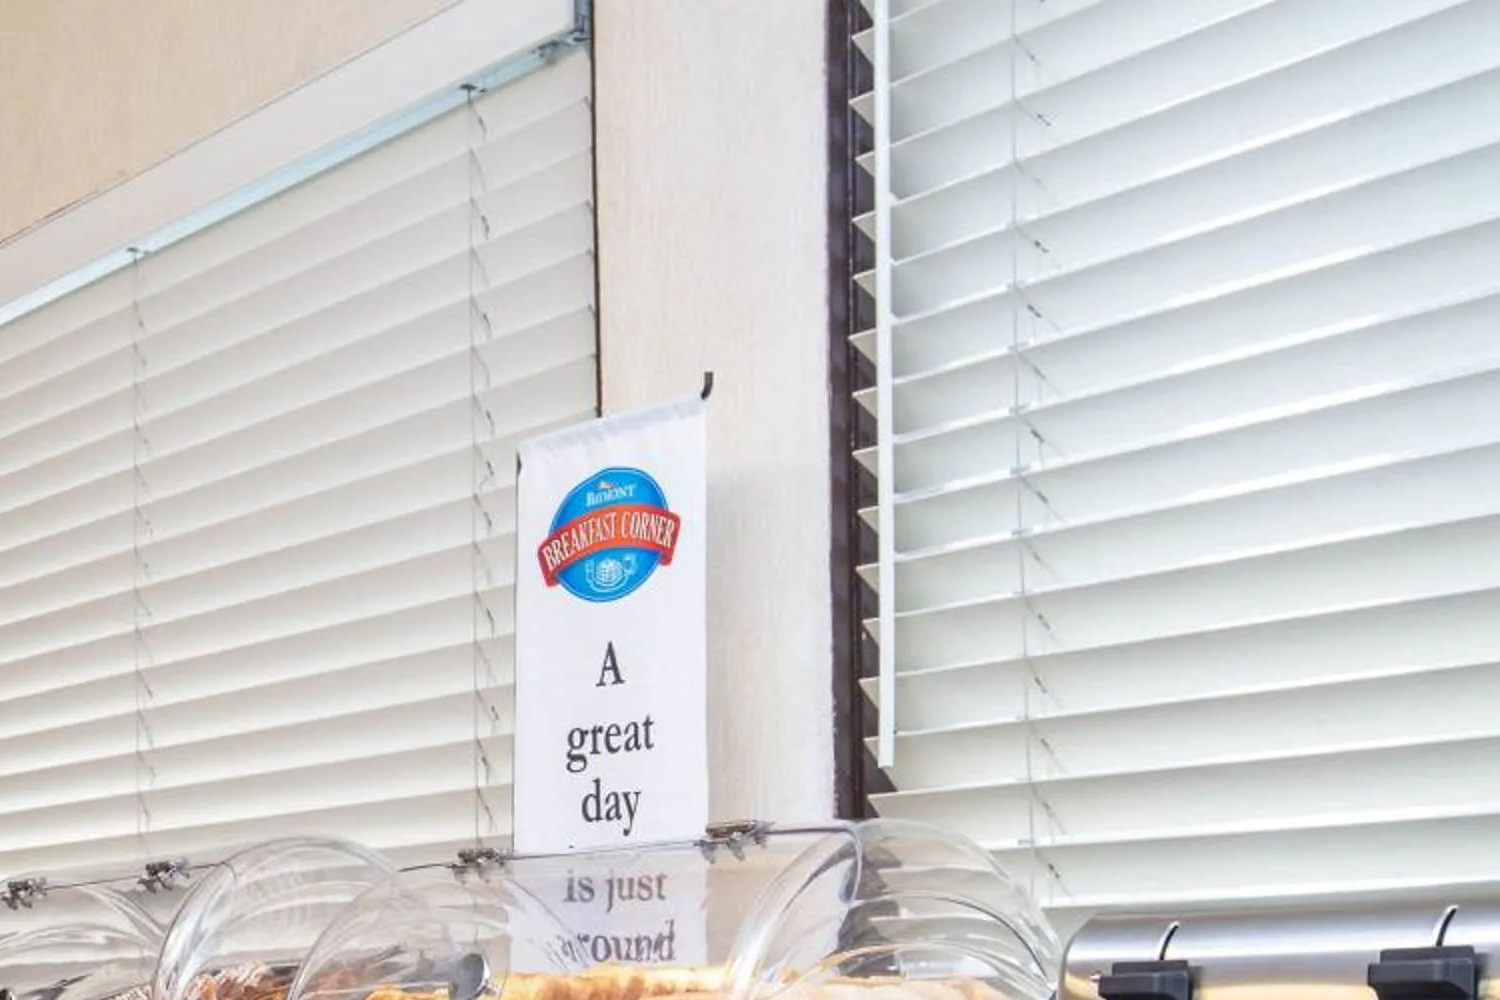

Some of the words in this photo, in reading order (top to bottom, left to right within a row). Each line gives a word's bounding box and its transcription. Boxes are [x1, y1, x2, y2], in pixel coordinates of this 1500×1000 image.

[542, 511, 617, 571] BREAKFAST
[621, 511, 675, 548] CORNER
[595, 640, 625, 687] A
[566, 714, 654, 773] great
[581, 777, 641, 836] day
[563, 868, 596, 904] is
[605, 867, 668, 914] just
